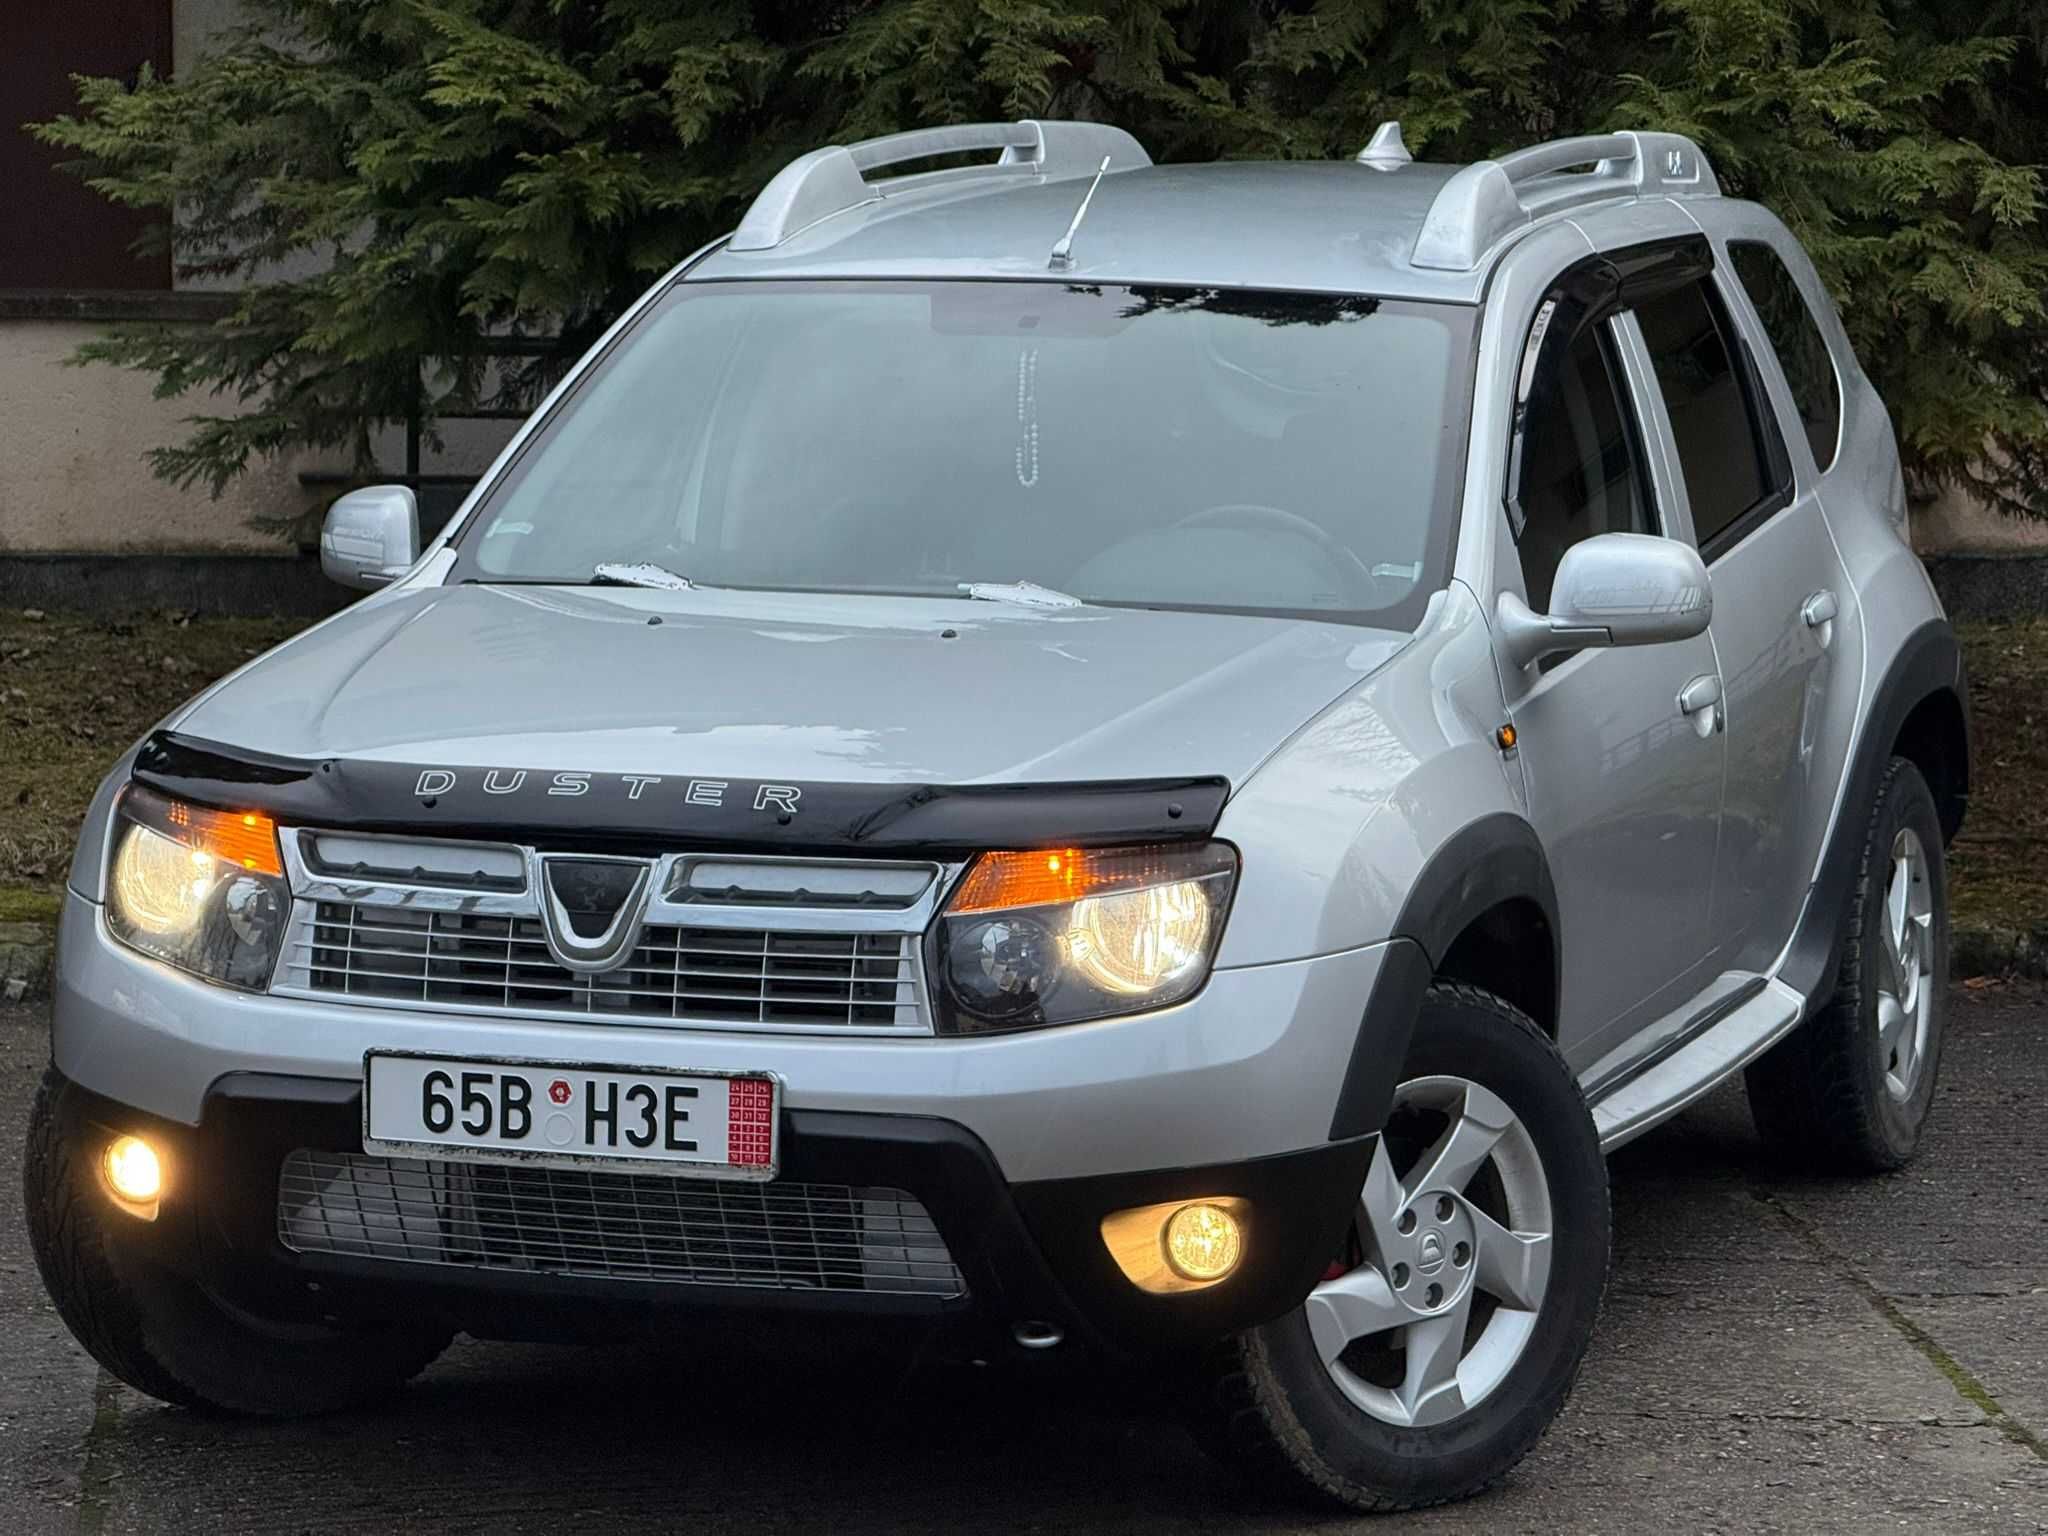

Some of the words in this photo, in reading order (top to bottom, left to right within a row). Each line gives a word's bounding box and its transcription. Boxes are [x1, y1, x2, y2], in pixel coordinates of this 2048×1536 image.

[415, 770, 801, 813] DUSTER
[422, 1070, 533, 1139] 65B
[585, 1081, 699, 1151] H3E
